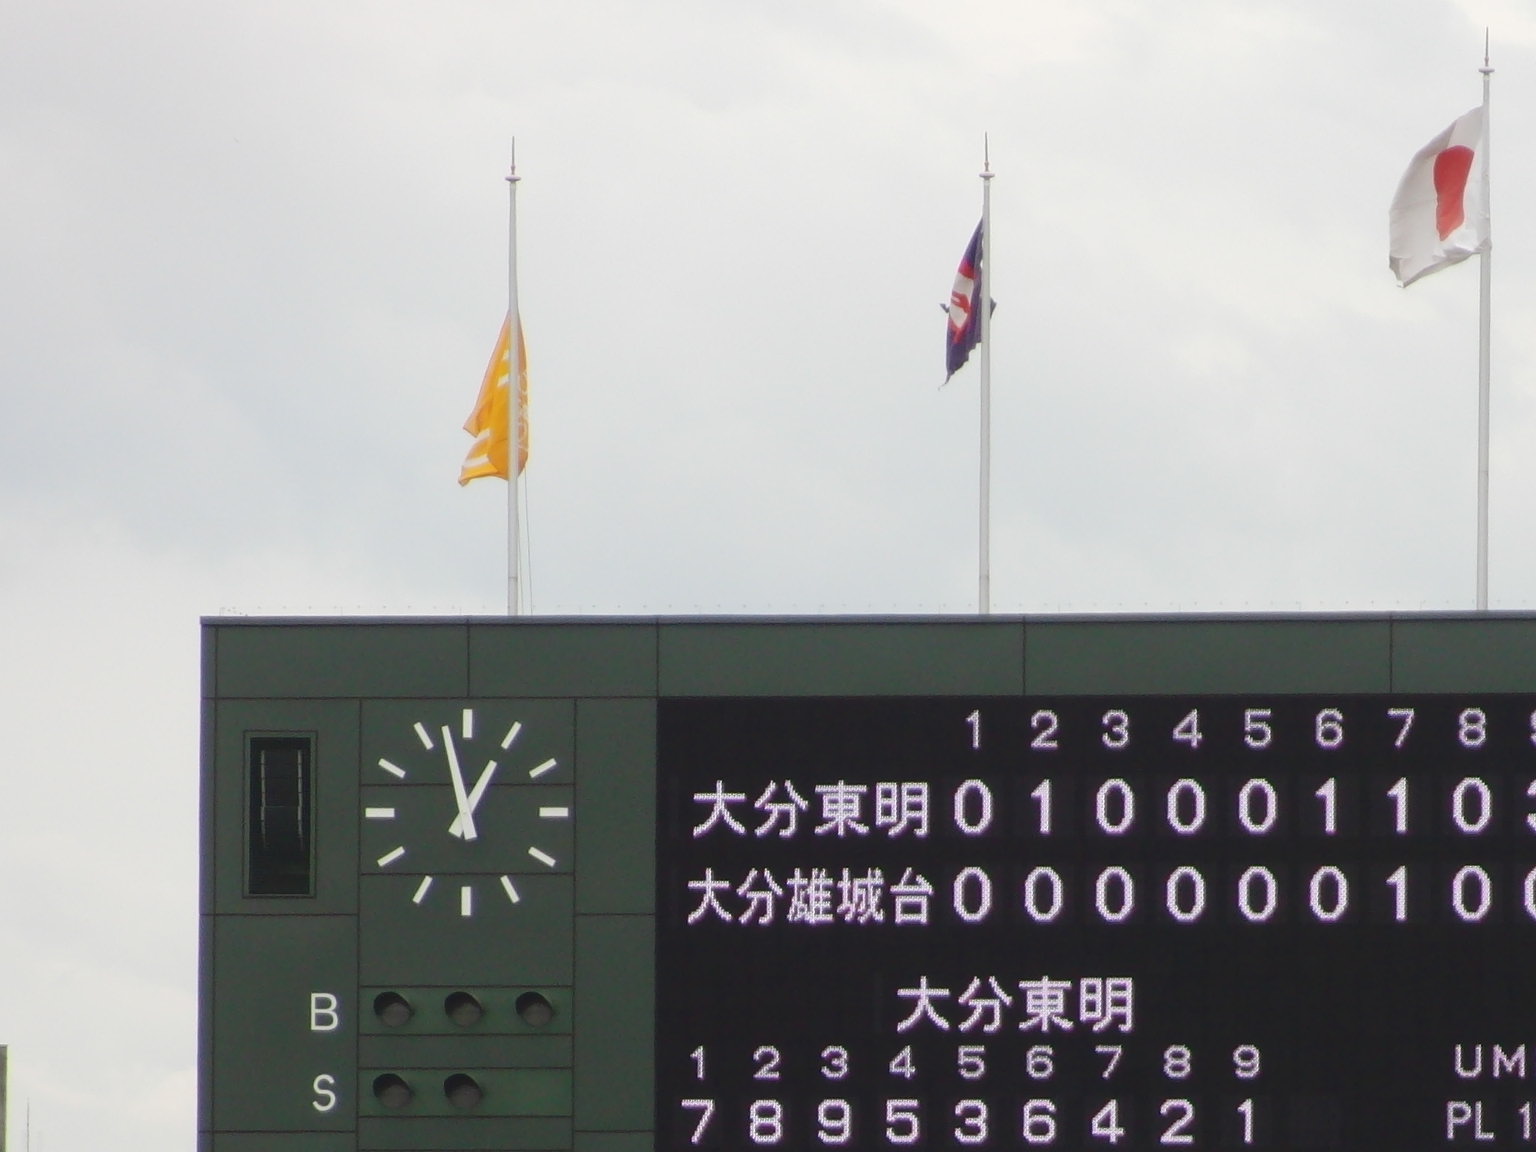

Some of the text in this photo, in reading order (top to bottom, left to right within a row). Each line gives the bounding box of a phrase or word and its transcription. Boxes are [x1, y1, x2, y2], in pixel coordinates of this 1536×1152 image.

[966, 709, 980, 748] 1
[1030, 709, 1058, 748] 2
[1102, 709, 1129, 748] 3
[1173, 708, 1203, 747] 4
[1244, 708, 1272, 747] 5
[1316, 708, 1343, 747] 6
[1387, 707, 1415, 747] 7
[1459, 708, 1486, 746] 8
[693, 779, 929, 837] 大分東明
[954, 779, 992, 834] 0
[1031, 779, 1050, 833] 1
[1096, 778, 1134, 834] 0
[1167, 778, 1206, 833] 0
[1238, 778, 1277, 833] 0
[1315, 777, 1336, 833] 1
[1387, 777, 1407, 833] 1
[1452, 777, 1491, 832] 0
[687, 867, 934, 925] 大分雄城台
[953, 866, 991, 922] 0
[1024, 866, 1063, 921] 0
[1095, 866, 1134, 921] 0
[1166, 866, 1205, 921] 0
[1238, 865, 1277, 921] 0
[1309, 865, 1348, 921] 0
[1386, 865, 1406, 921] 1
[1452, 865, 1491, 921] 0
[310, 992, 339, 1031] B
[896, 975, 1133, 1032] 大分東明
[690, 1044, 1260, 1079] 1 2 3 4 5 6 7 8 9
[312, 1073, 336, 1112] S
[681, 1098, 1252, 1144] 7 8 9 5 3 6 4 2 1
[1447, 1100, 1494, 1140] PL
